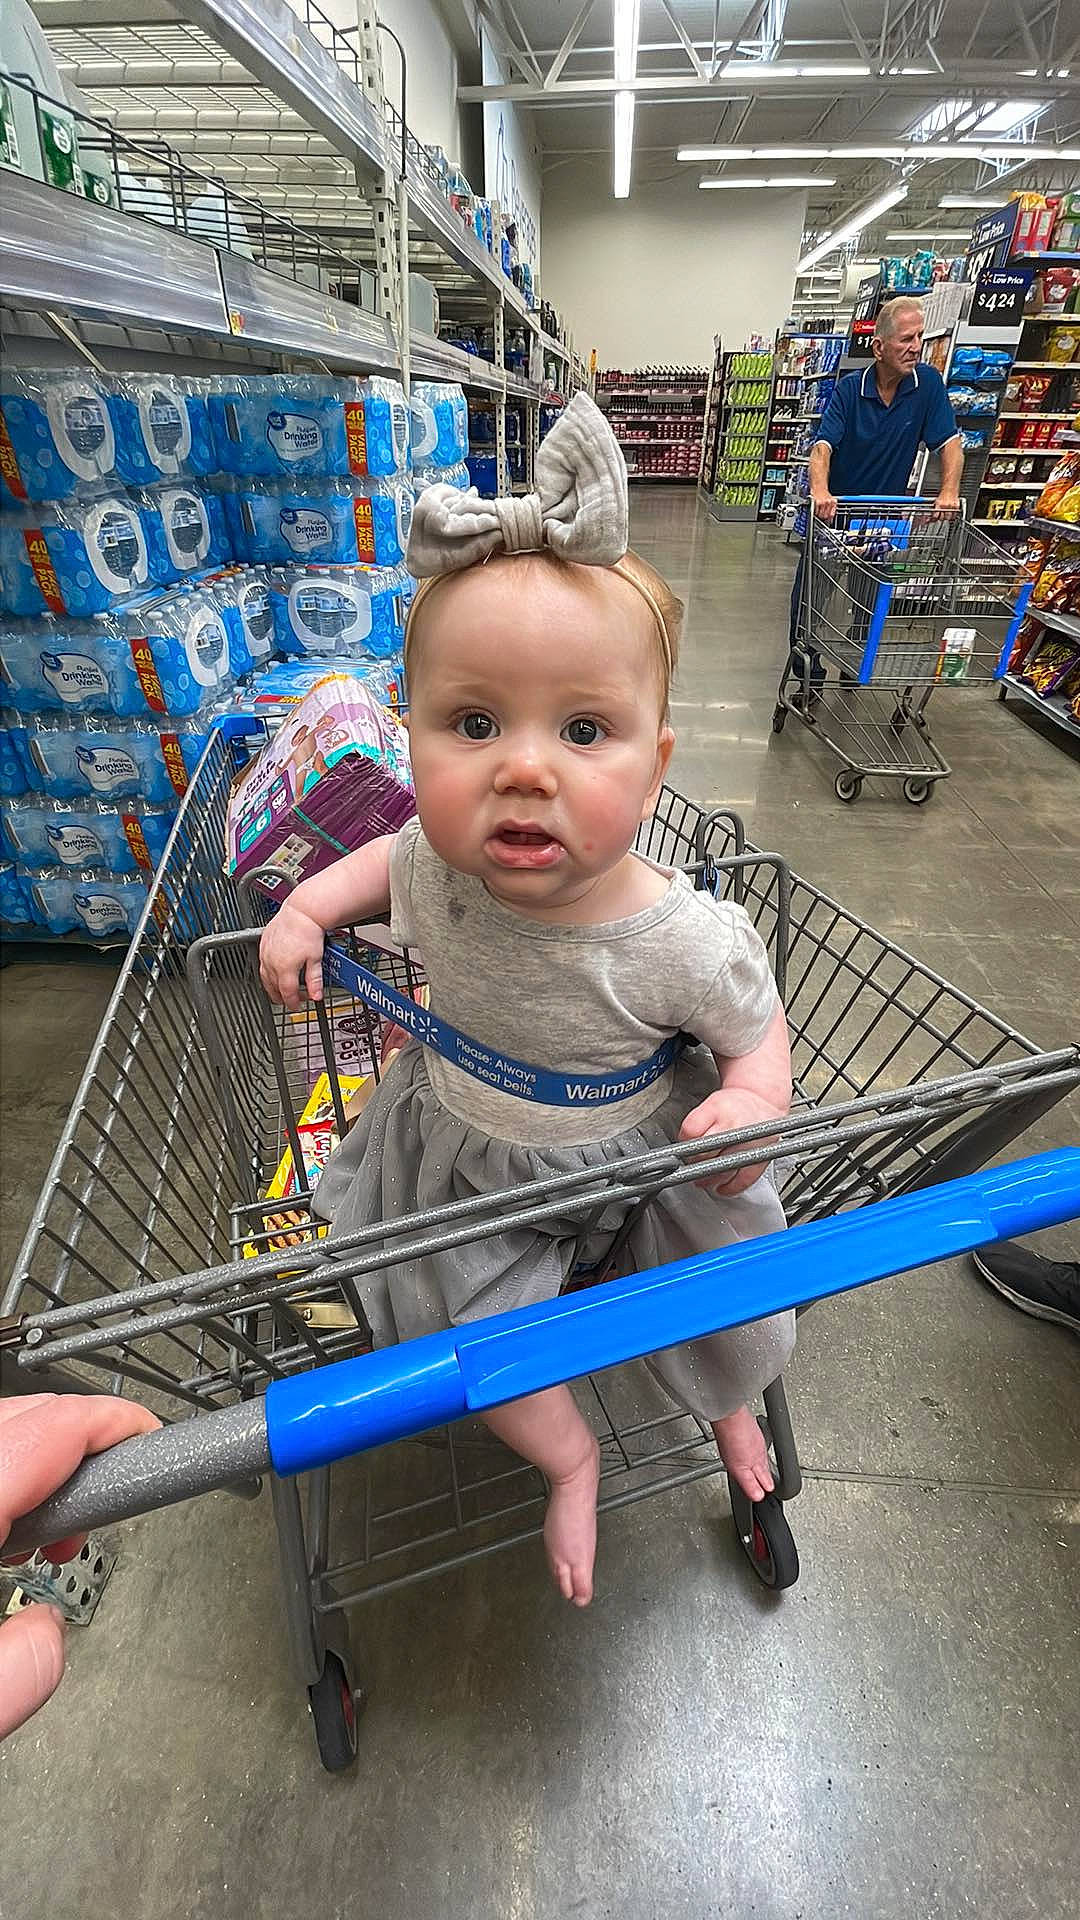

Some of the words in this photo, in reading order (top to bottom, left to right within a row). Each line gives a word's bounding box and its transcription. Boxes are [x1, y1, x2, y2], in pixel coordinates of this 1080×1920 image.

[992, 274, 1007, 284] Low
[1007, 275, 1024, 285] Price
[978, 293, 1016, 312] $424
[347, 409, 364, 421] 40
[284, 431, 318, 441] Drinking
[294, 439, 318, 449] Water
[349, 434, 360, 465] PACK
[357, 434, 367, 465] VALUE
[354, 503, 372, 517] 40
[295, 525, 328, 535] Drinking
[358, 526, 368, 553] PACK
[29, 540, 48, 555] 40
[134, 648, 152, 662] 40
[61, 671, 103, 682] Drinking
[140, 672, 155, 699] PACK
[163, 742, 182, 755] 40
[94, 762, 133, 773] Drinking
[125, 821, 142, 834] 40
[356, 974, 417, 1029] Walmart
[456, 1037, 493, 1066] Please:
[494, 1059, 537, 1084] Always
[457, 1054, 475, 1071] use
[477, 1066, 501, 1084] seat
[503, 1076, 535, 1097] belts.
[565, 1069, 649, 1101] Walmart
